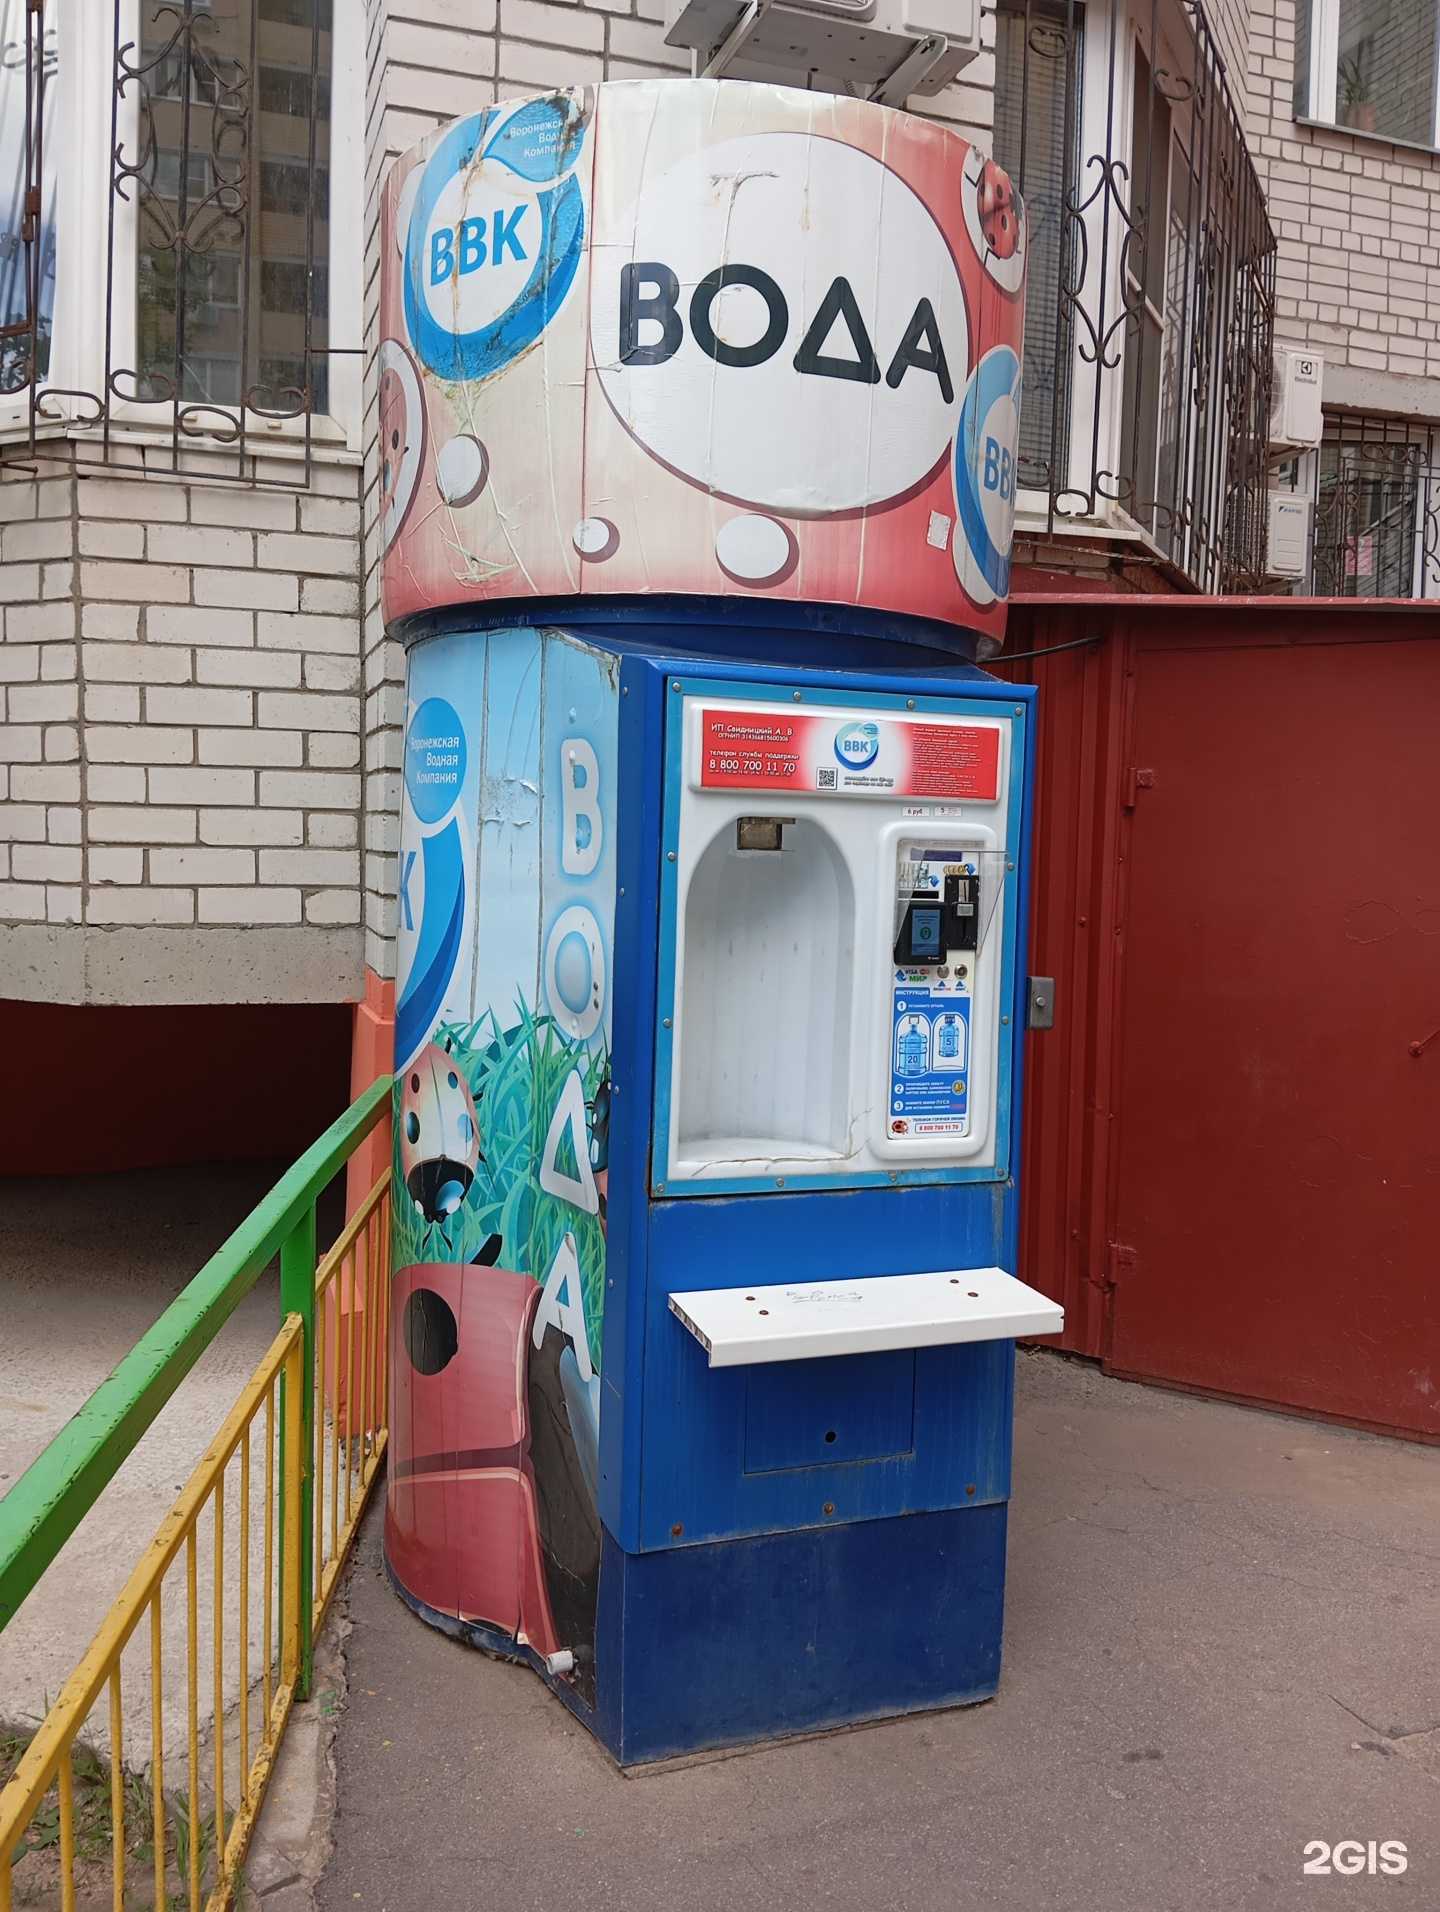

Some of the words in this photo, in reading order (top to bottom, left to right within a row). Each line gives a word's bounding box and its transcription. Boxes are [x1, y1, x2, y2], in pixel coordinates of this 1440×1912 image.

[510, 119, 564, 138] Воронежск
[430, 203, 529, 287] ВВК
[618, 261, 955, 405] ВОДА
[711, 723, 724, 732] ИП
[843, 740, 869, 753] ВВК
[426, 752, 458, 767] Водная
[709, 750, 737, 758] телефон
[739, 751, 763, 759] службы
[709, 759, 716, 769] 8
[720, 759, 739, 770] 800
[743, 760, 762, 771] 700
[766, 761, 777, 771] 11
[783, 762, 796, 772] 70
[416, 772, 458, 785] Компания
[945, 1037, 952, 1046] 5
[907, 1055, 918, 1064] 20
